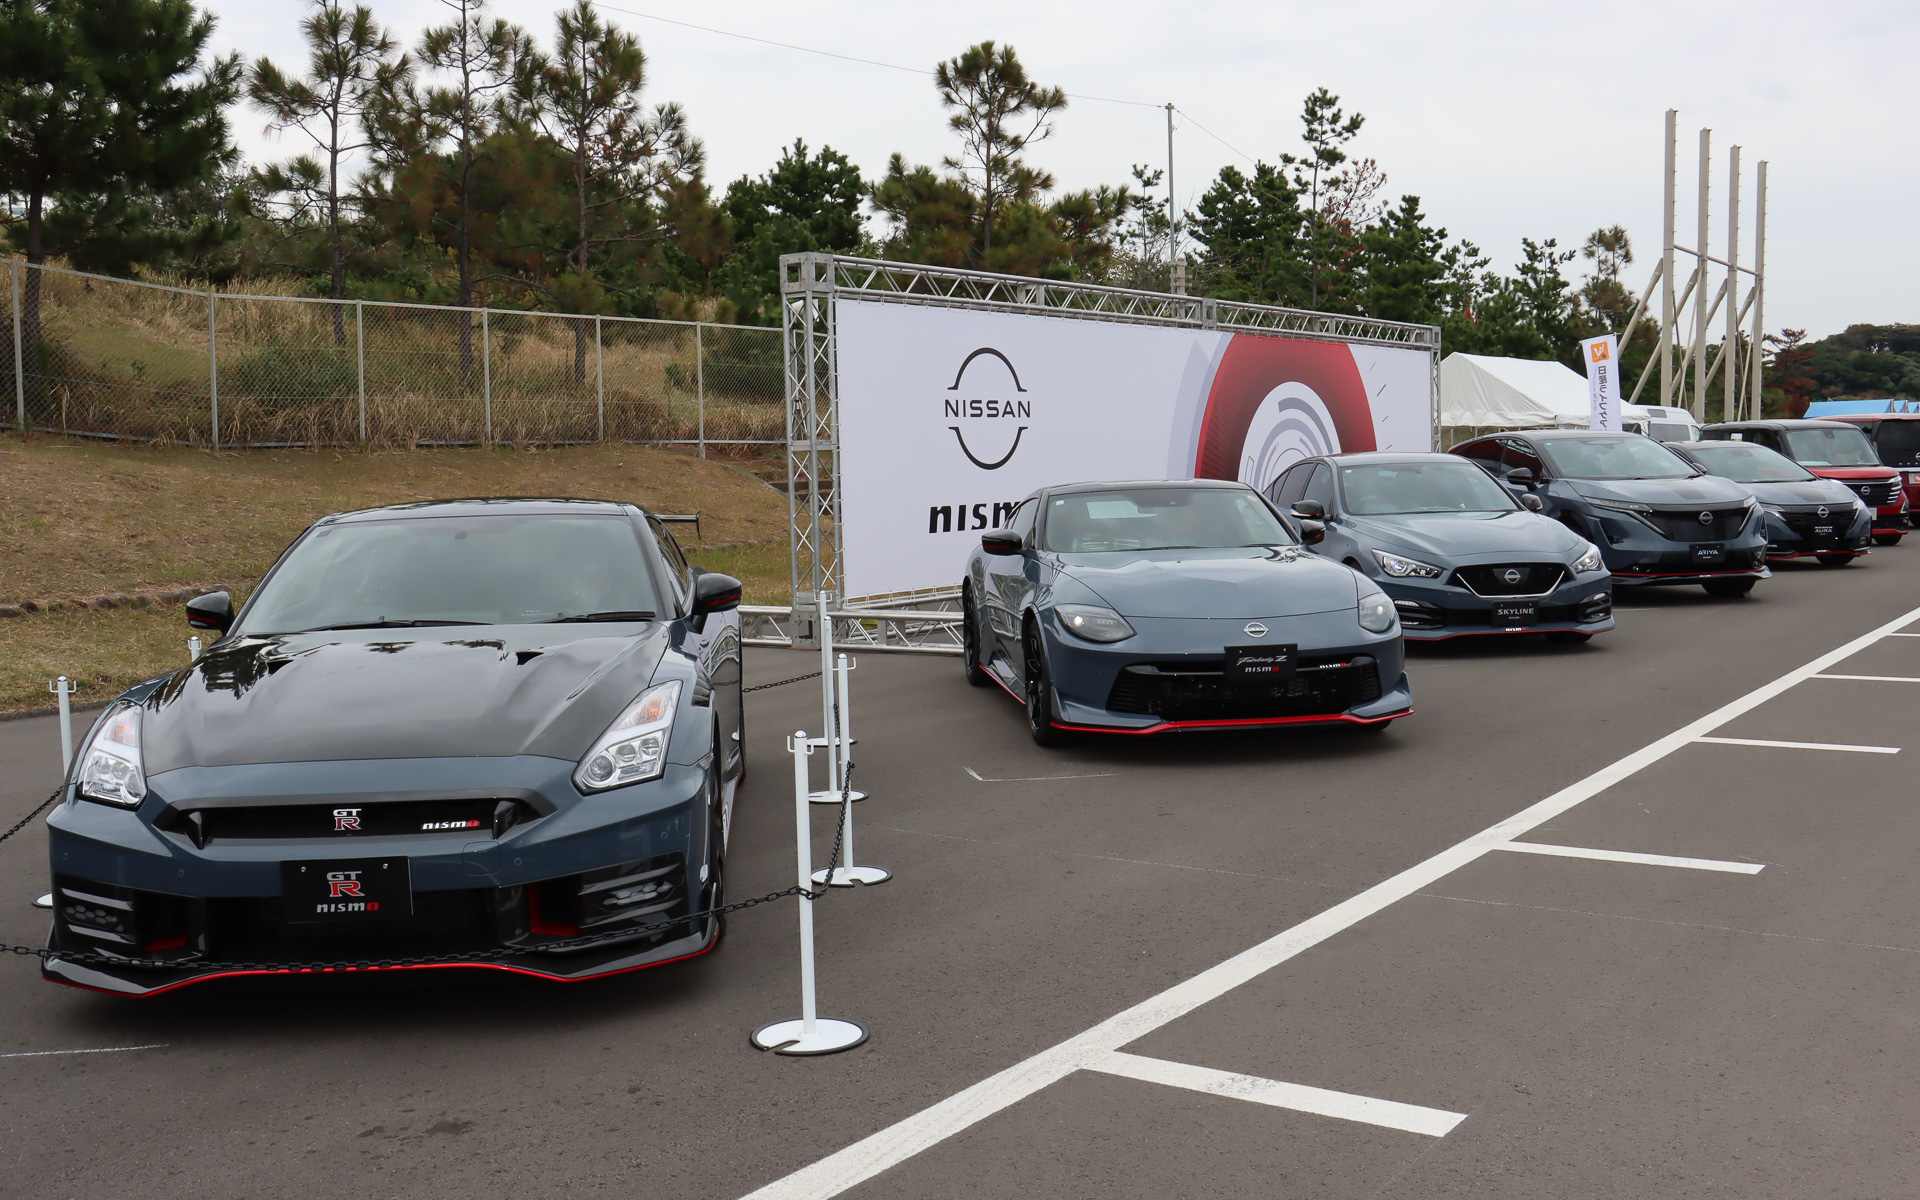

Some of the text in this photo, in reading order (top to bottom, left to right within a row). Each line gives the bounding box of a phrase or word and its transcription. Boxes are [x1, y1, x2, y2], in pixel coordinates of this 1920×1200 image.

[944, 399, 1031, 418] NISSAN
[929, 501, 1021, 534] nism
[333, 808, 362, 817] GT
[334, 817, 362, 831] R
[422, 820, 480, 830] nismo
[327, 871, 363, 881] GT
[329, 881, 365, 898] R
[317, 902, 380, 913] nismo
